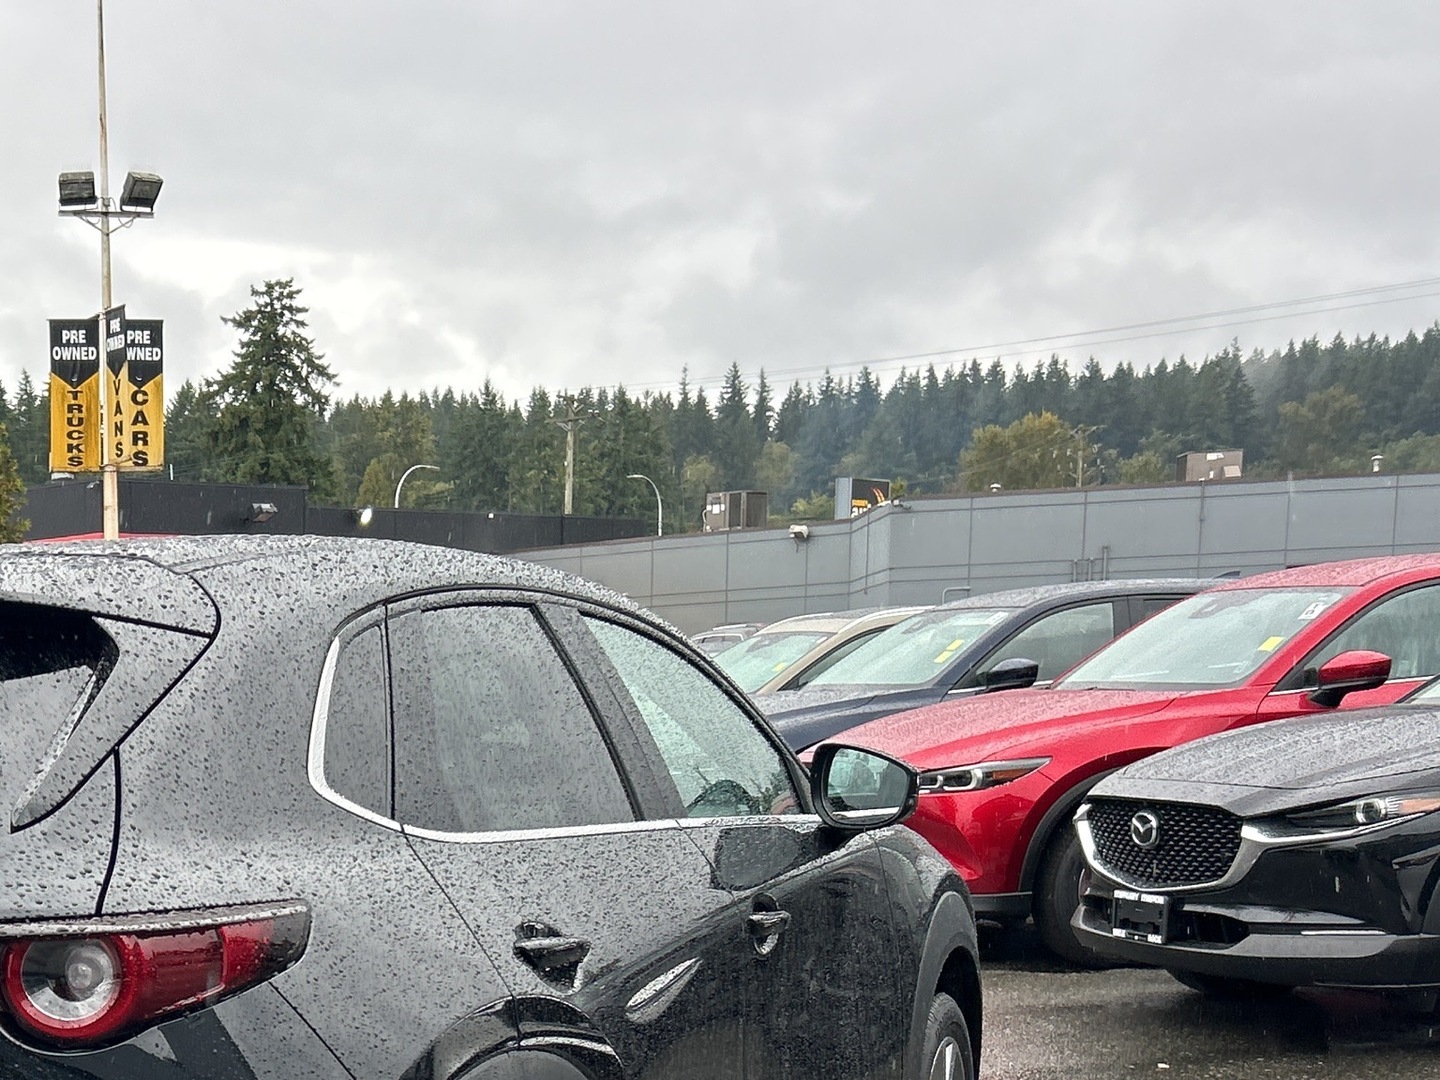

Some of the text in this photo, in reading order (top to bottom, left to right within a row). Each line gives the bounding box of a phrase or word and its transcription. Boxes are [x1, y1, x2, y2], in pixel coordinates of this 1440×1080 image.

[62, 330, 86, 344] PRE
[126, 330, 151, 344] PRE
[52, 346, 97, 361] OWNED
[126, 347, 162, 361] WNED
[113, 379, 123, 458] VANS
[66, 390, 85, 467] TRUCKS
[130, 390, 149, 467] CARS
